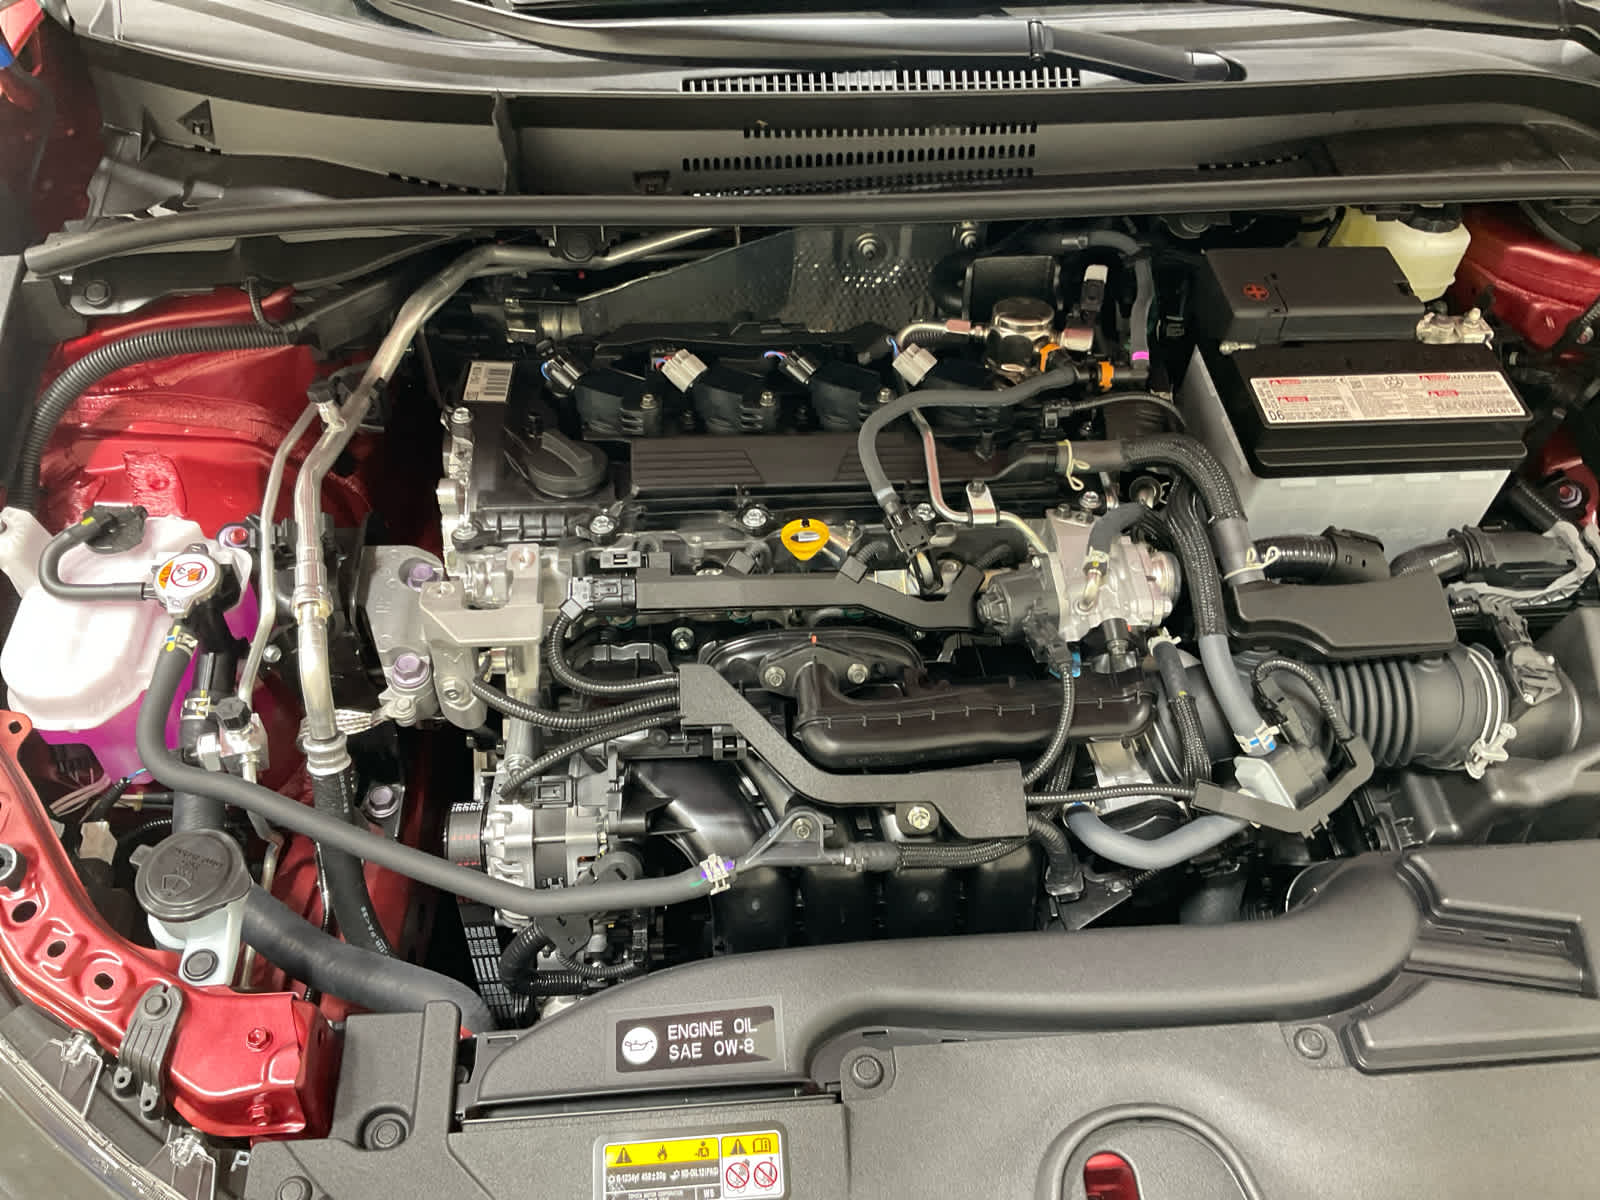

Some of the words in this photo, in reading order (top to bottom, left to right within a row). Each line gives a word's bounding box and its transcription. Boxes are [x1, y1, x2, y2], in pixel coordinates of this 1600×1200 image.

[667, 1020, 723, 1041] ENGINE
[733, 1017, 758, 1034] OIL
[668, 1042, 703, 1060] SAE
[713, 1038, 755, 1057] 0W-8
